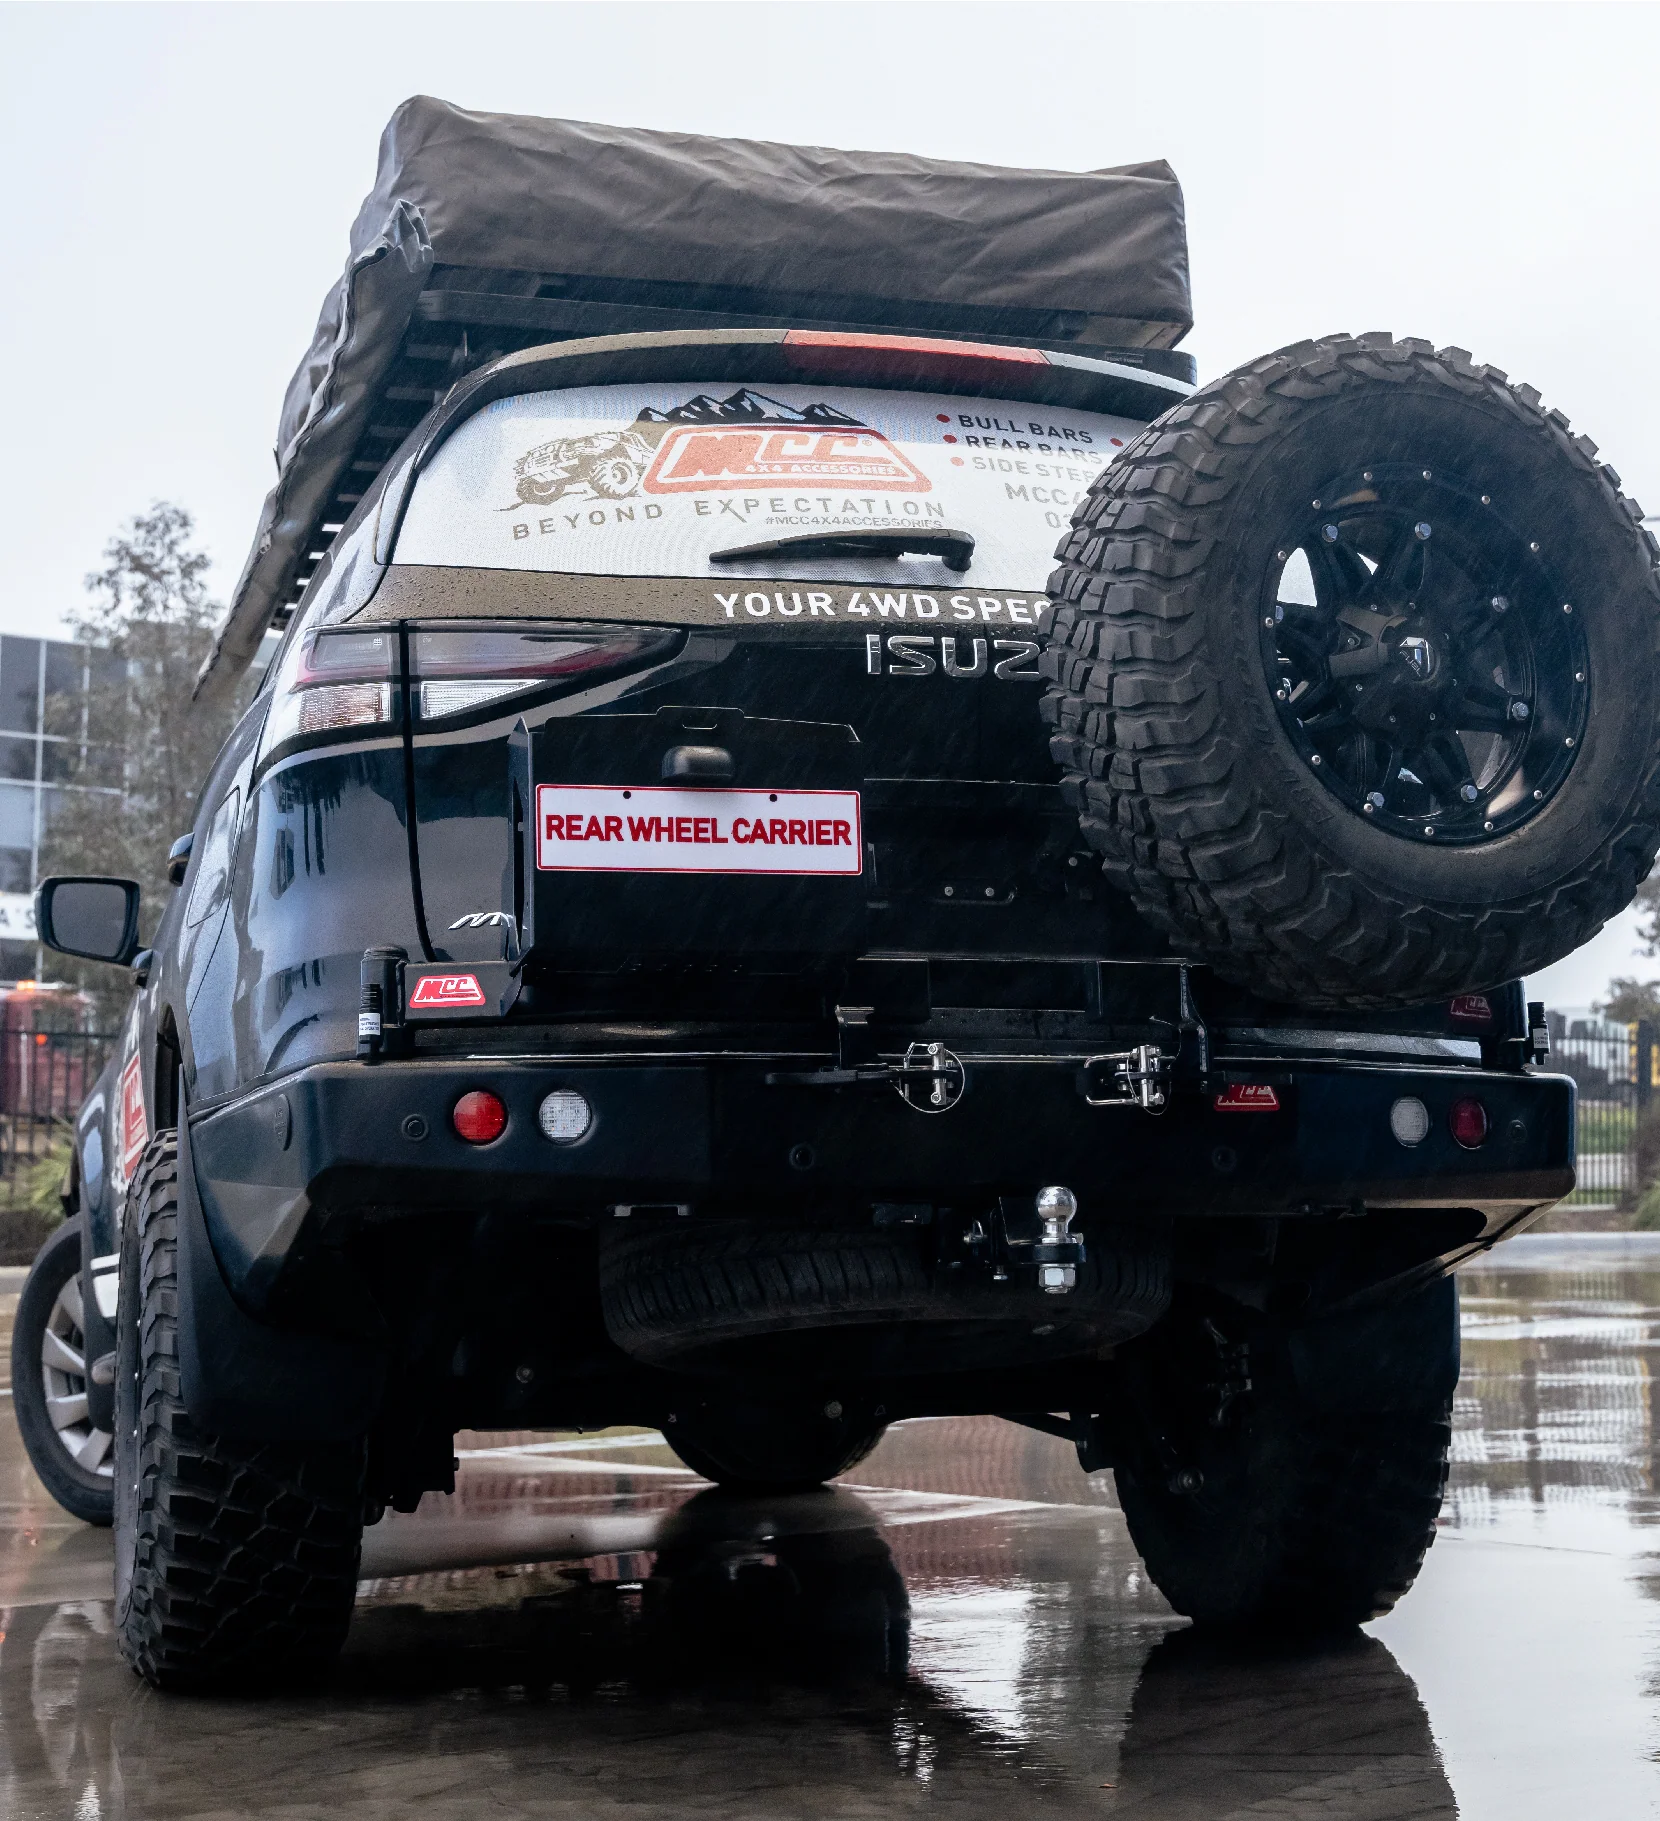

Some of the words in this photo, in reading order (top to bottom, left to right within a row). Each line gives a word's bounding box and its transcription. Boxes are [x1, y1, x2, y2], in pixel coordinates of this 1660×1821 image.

[958, 414, 1024, 433] BULL
[1028, 422, 1093, 444] BARS
[668, 433, 893, 476] MCC
[965, 435, 1033, 454] REAR
[1037, 443, 1102, 464] BARS
[745, 464, 783, 473] 4X4
[791, 463, 896, 475] ACCESSORIES
[972, 456, 1030, 475] SIDE
[513, 503, 663, 541] BEYOND
[694, 498, 946, 523] EXPECTATION
[766, 516, 942, 529] #MCC4X4ACCESSORIES
[714, 592, 836, 618] YOUR
[847, 593, 940, 619] 4WD
[546, 814, 623, 841] REAR
[627, 816, 728, 844] WHEEL
[731, 818, 852, 846] CARRIER
[415, 979, 476, 1000] MCC
